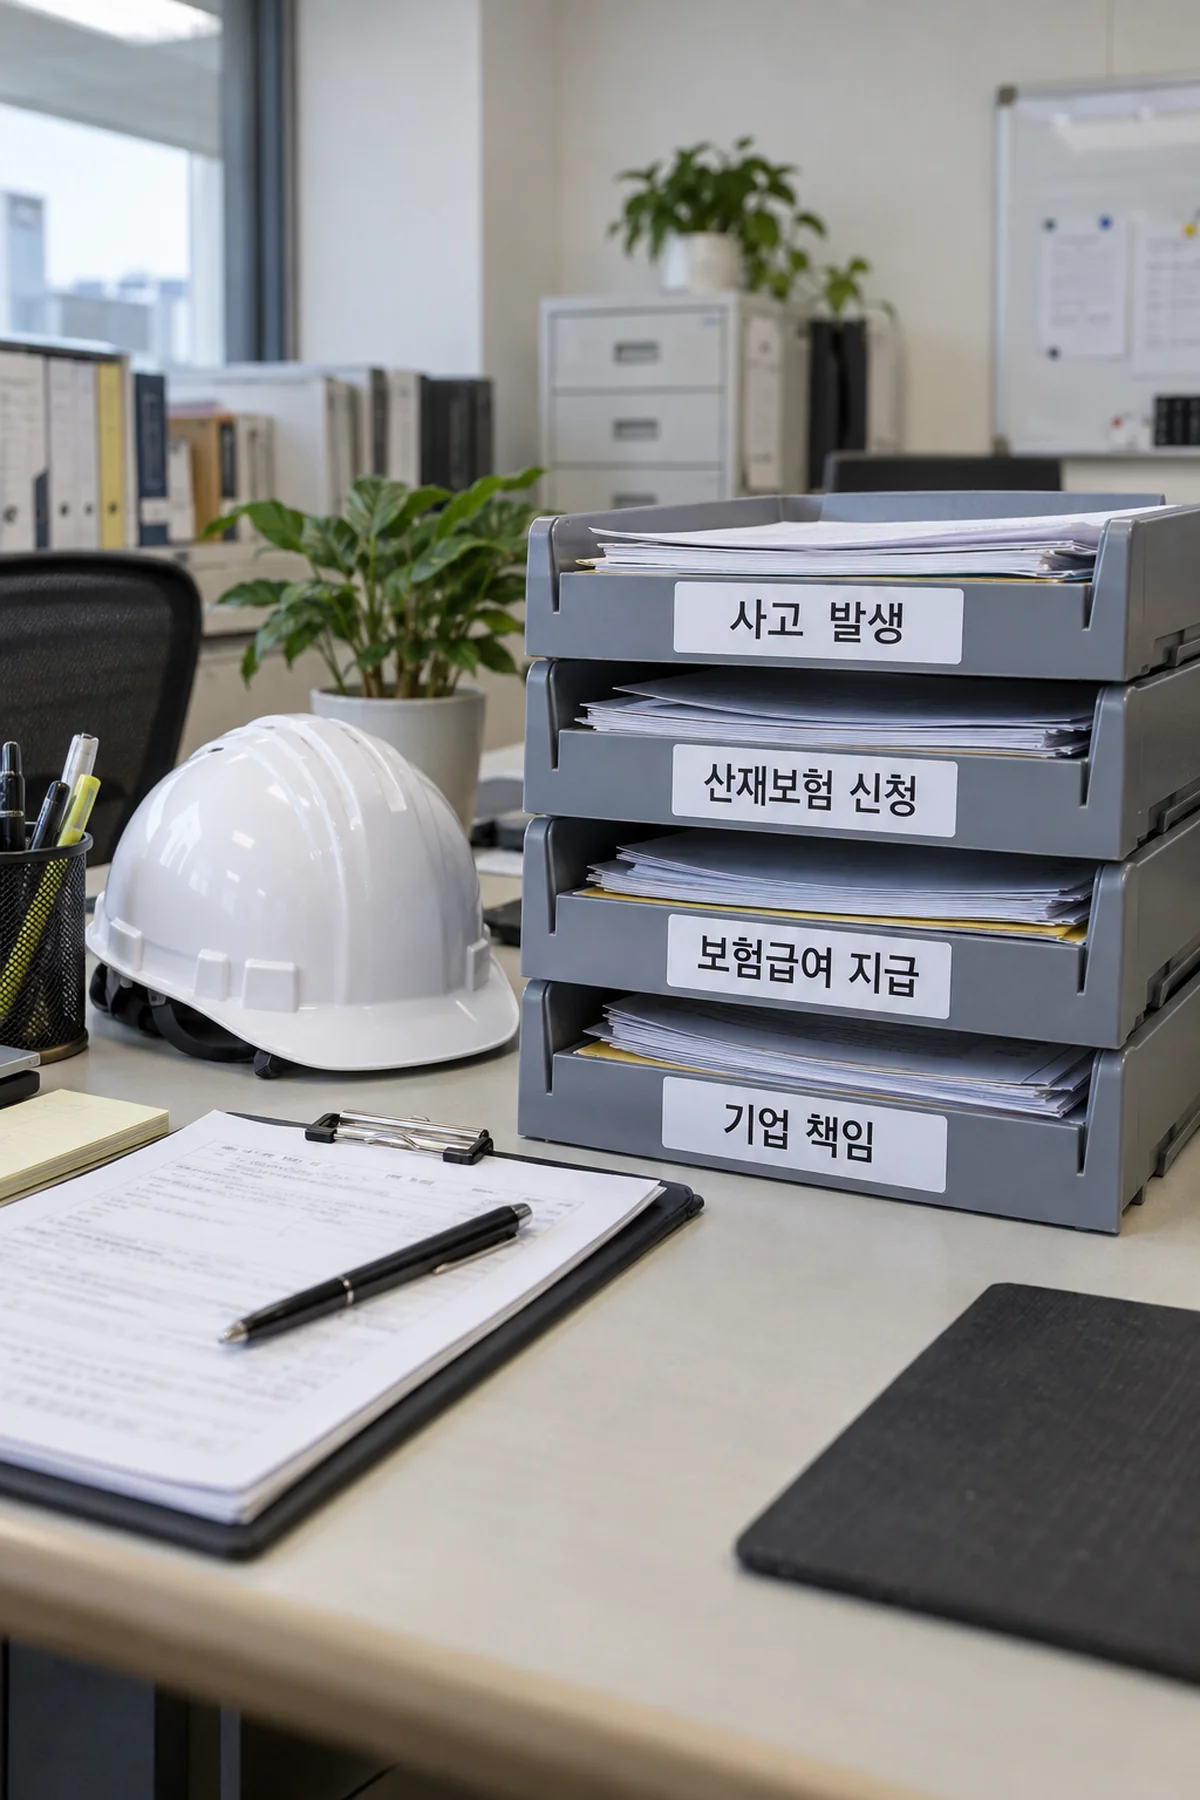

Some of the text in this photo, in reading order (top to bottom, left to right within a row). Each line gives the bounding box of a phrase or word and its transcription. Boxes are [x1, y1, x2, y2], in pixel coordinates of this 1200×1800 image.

[730, 598, 903, 645] 사고 발생
[704, 763, 916, 818] 산재보험 신청
[697, 934, 920, 998] 보험급여 지급
[724, 1103, 874, 1164] 기업 책임
